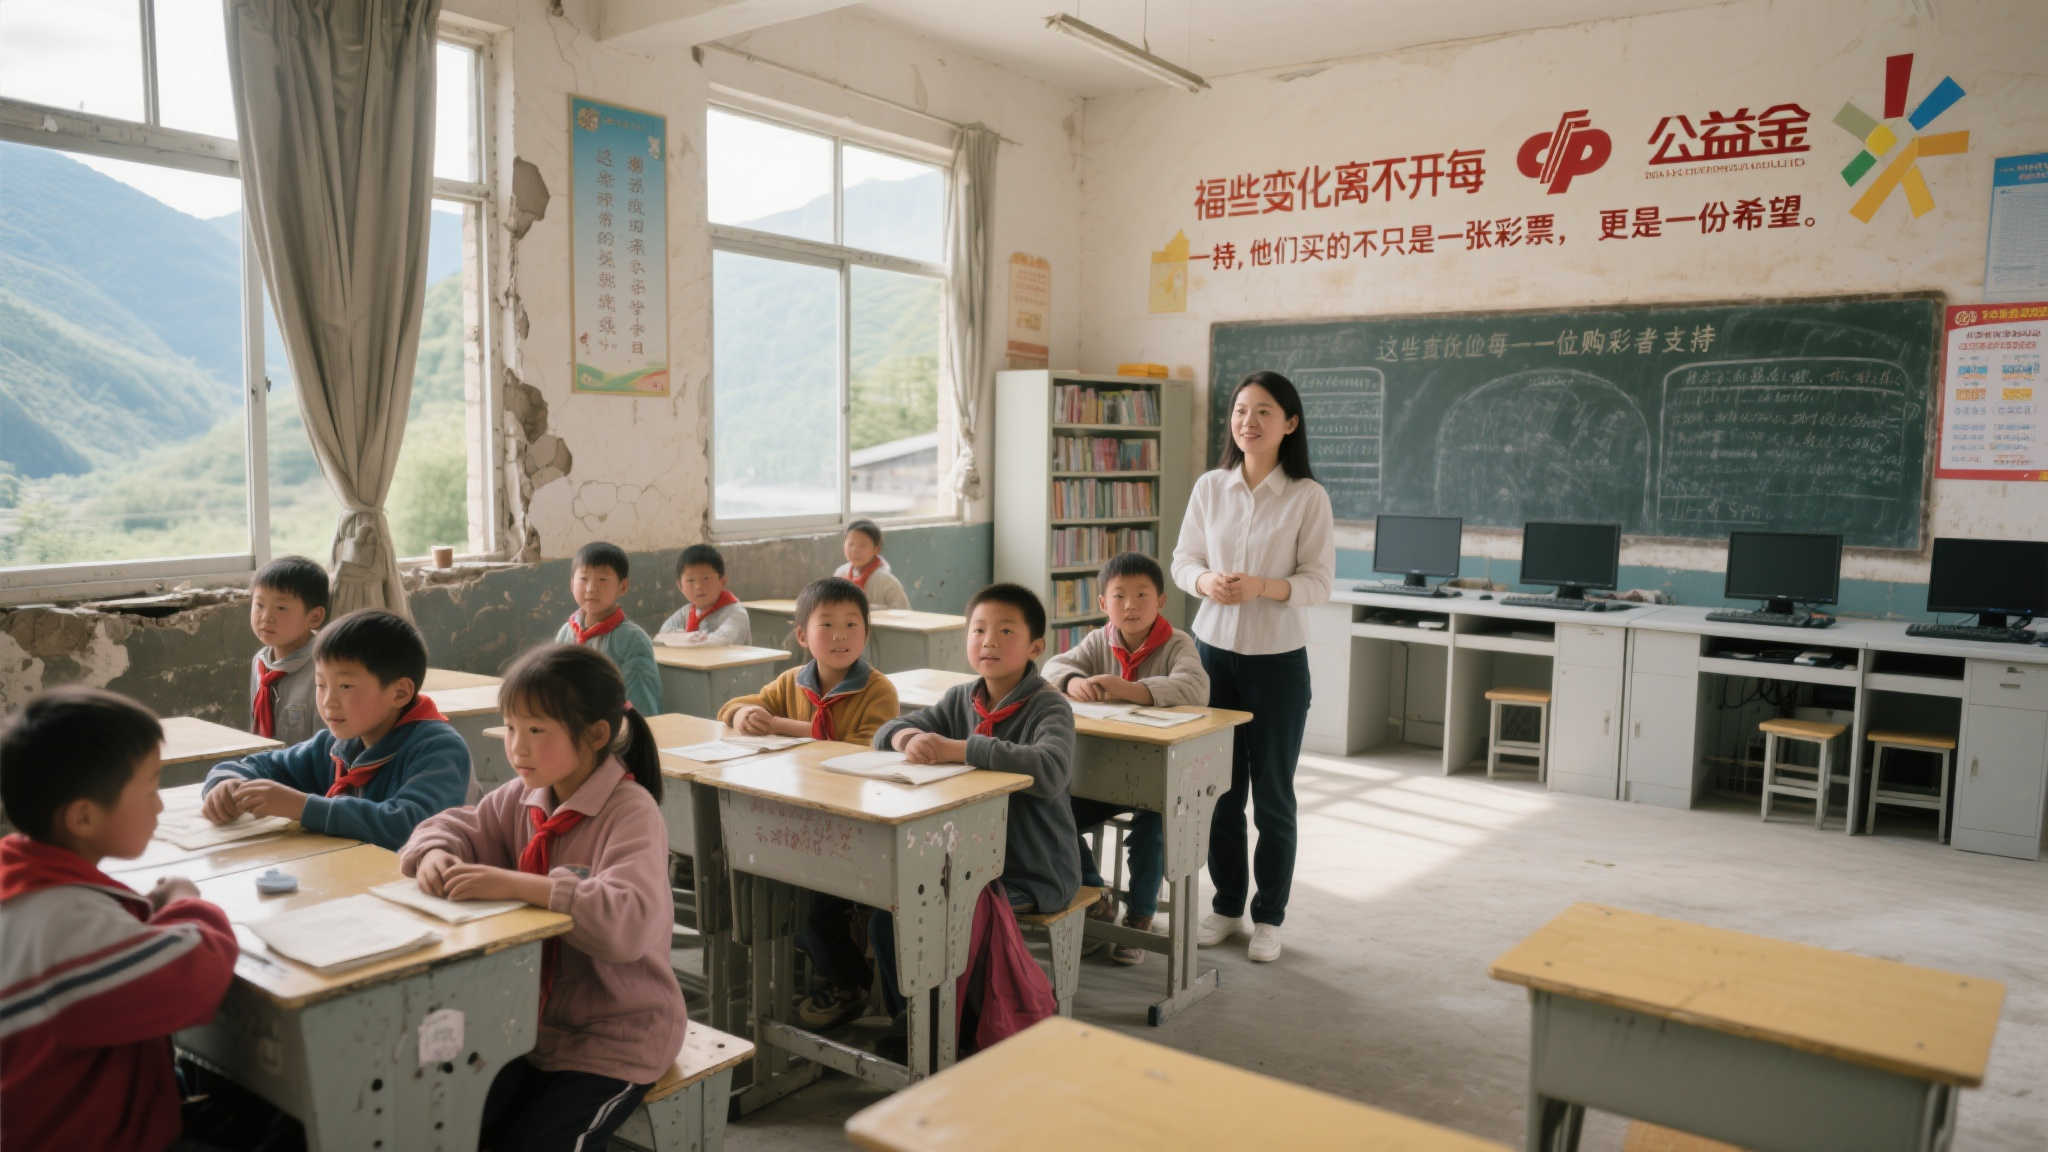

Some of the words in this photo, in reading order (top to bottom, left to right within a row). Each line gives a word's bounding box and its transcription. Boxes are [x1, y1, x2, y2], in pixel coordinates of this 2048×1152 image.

[1648, 102, 1811, 166] 公益金
[1194, 148, 1486, 220] 福些变化离不开每
